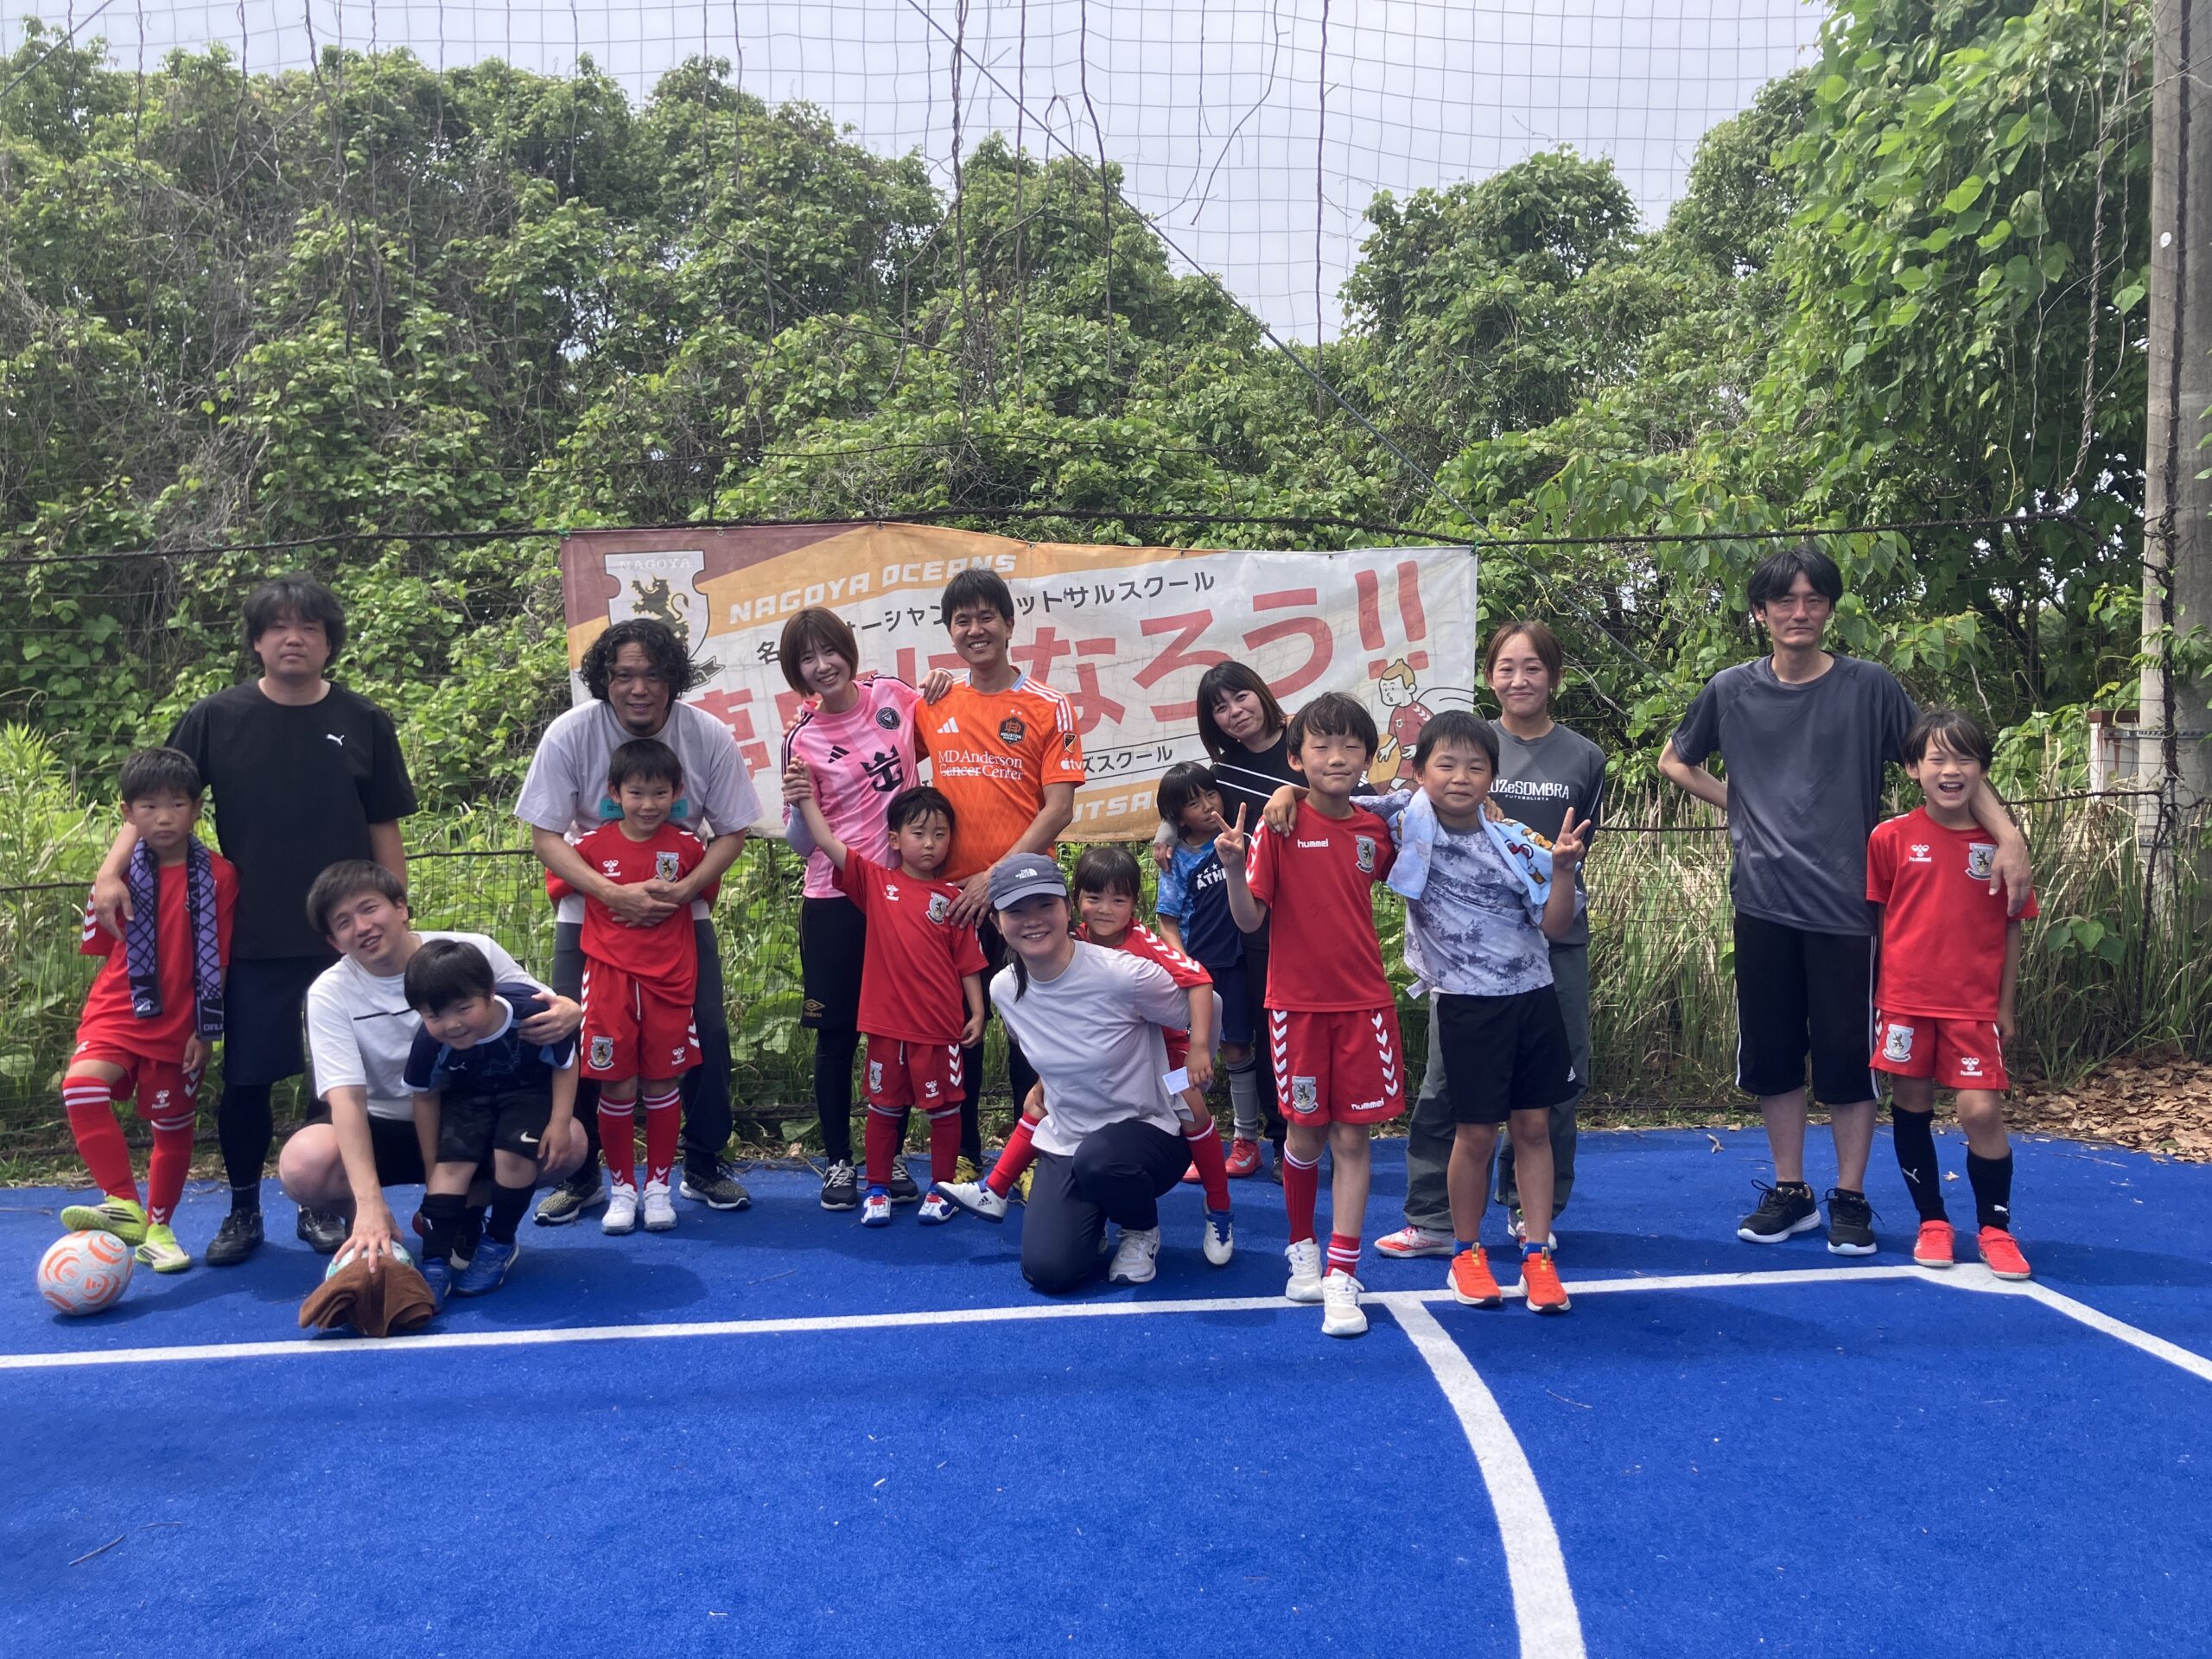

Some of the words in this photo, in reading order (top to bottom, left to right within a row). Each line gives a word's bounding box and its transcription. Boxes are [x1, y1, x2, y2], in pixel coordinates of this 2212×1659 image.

[620, 557, 692, 571] NAGOYA
[729, 572, 870, 625] NAGOYA
[882, 555, 1016, 588] OCEANS
[938, 750, 959, 763] MD
[960, 750, 1023, 769] Anderson
[939, 764, 981, 777] Cancer
[982, 766, 1024, 780] Center
[1487, 779, 1569, 800] UZeSOMBRA
[1297, 837, 1329, 849] hummel
[1351, 1096, 1384, 1110] hummel
